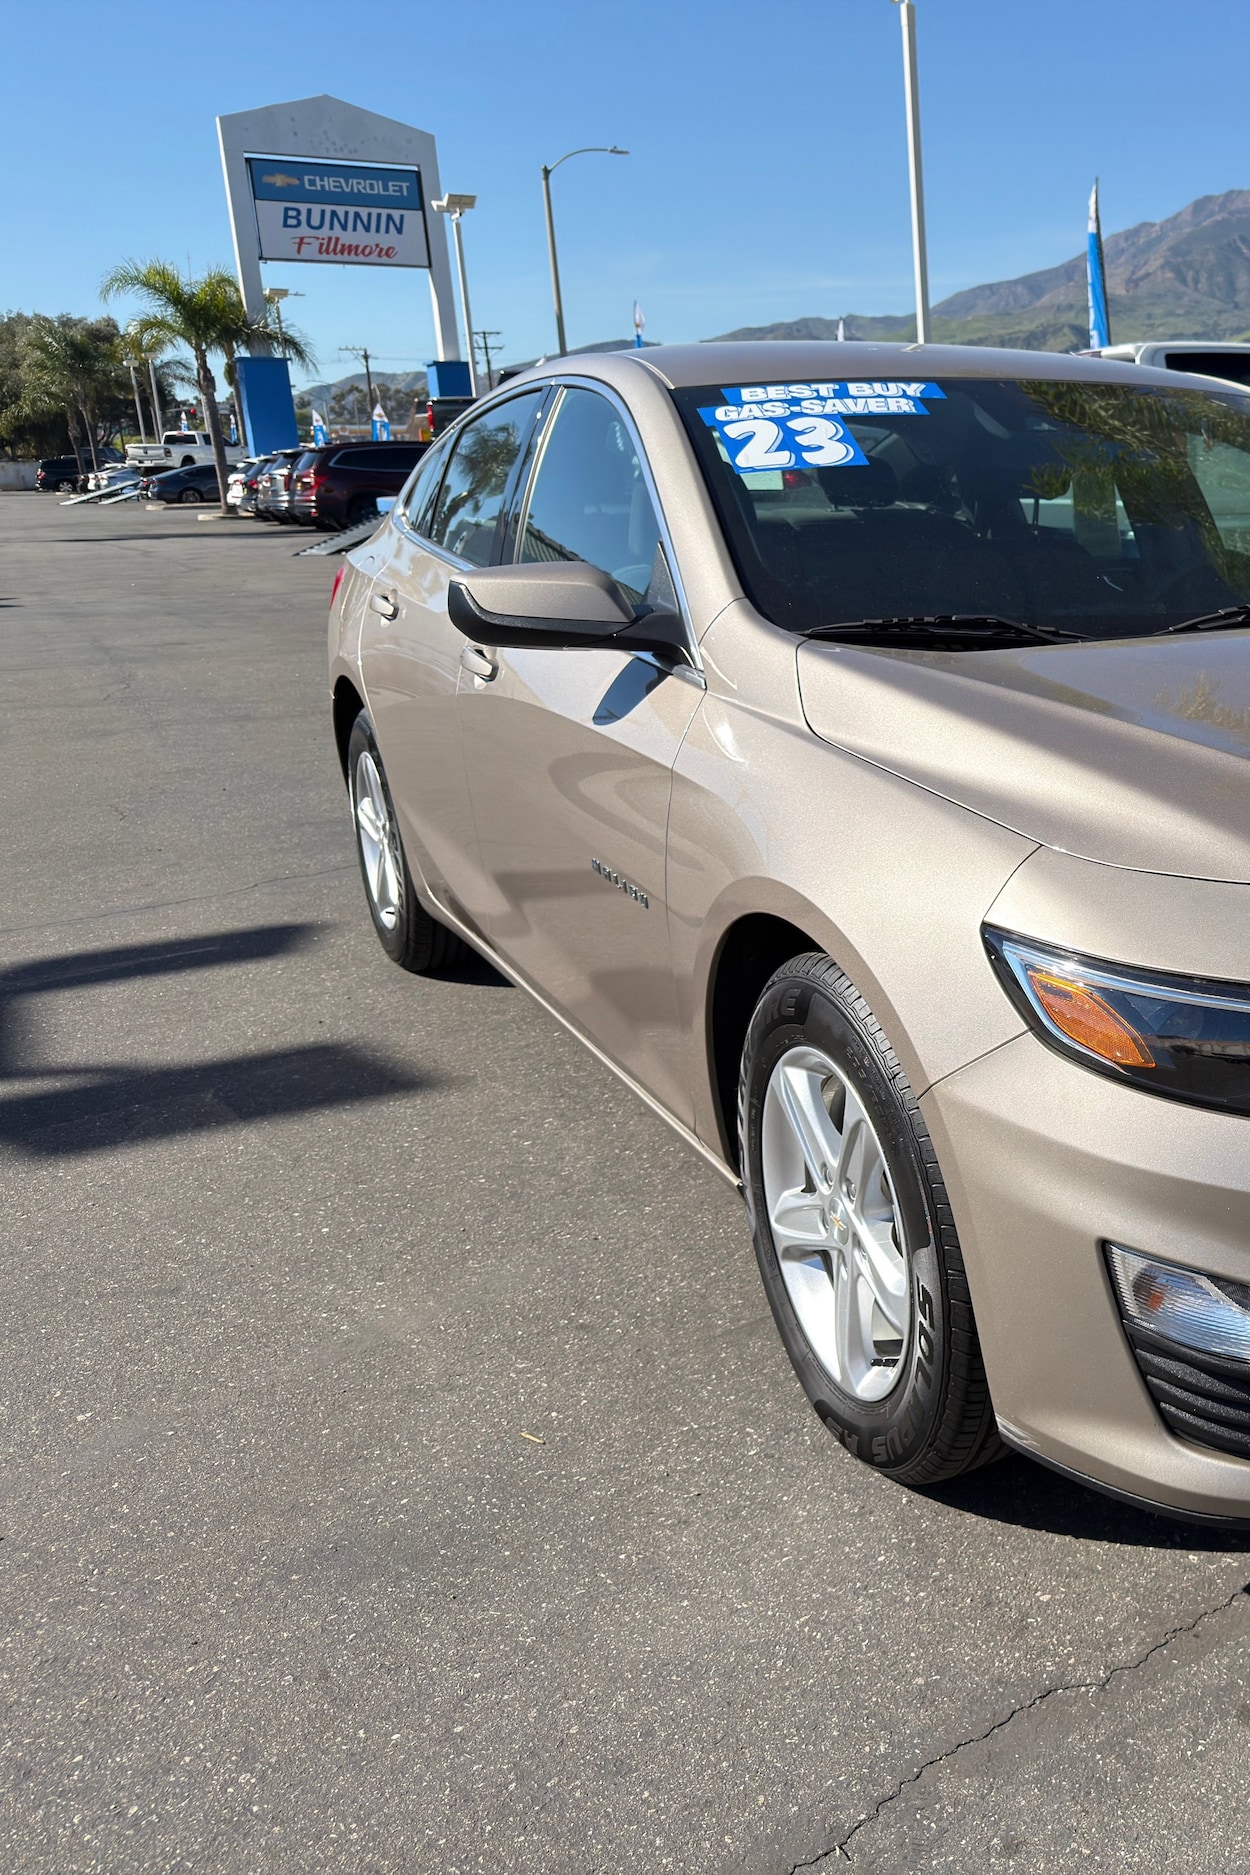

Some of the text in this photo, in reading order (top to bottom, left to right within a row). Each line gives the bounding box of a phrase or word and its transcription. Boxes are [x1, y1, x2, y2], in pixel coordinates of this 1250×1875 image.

[303, 174, 410, 197] CHEVROLET
[282, 206, 405, 235] BUNNIN
[290, 235, 398, 259] Fillmore
[740, 381, 926, 401] BEST BUY
[714, 397, 917, 422] GAS-SAVER
[722, 416, 855, 470] 23
